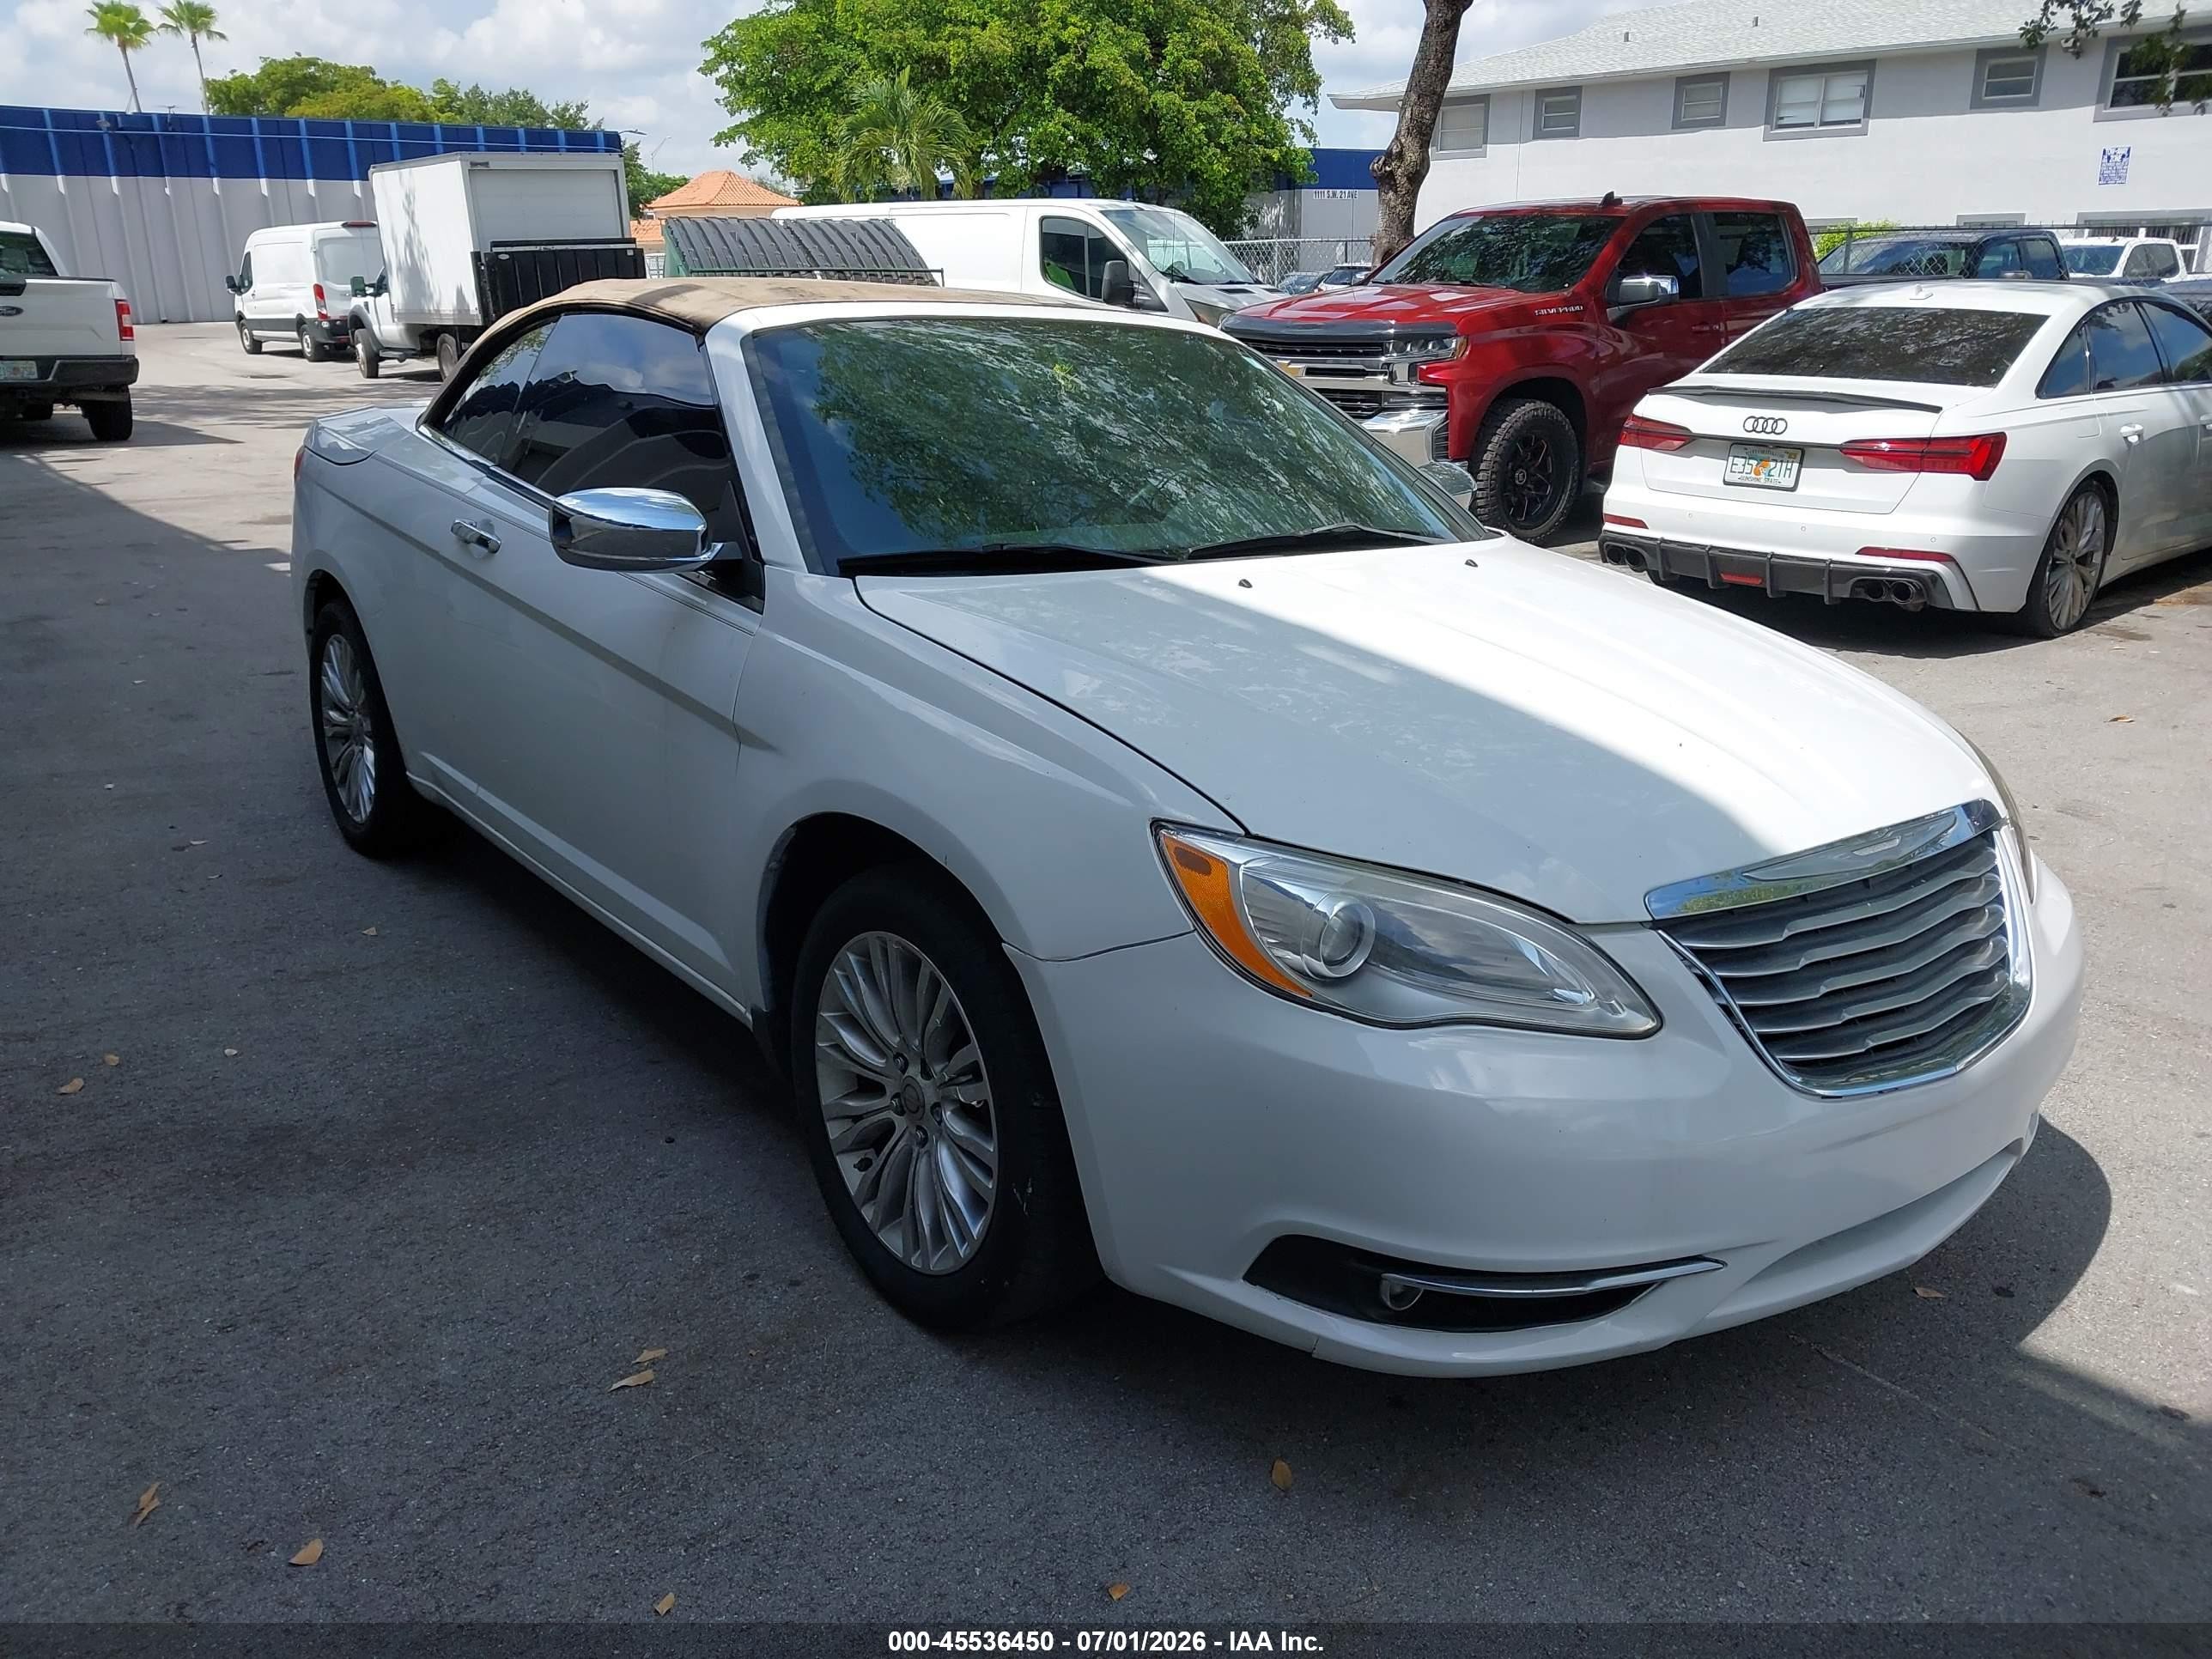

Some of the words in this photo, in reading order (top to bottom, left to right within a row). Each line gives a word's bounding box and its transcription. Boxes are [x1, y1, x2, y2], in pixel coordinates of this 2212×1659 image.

[1314, 190, 1326, 199] 1111
[1327, 190, 1339, 199] S.W.
[1339, 190, 1346, 199] 21
[1347, 190, 1358, 199] AVE
